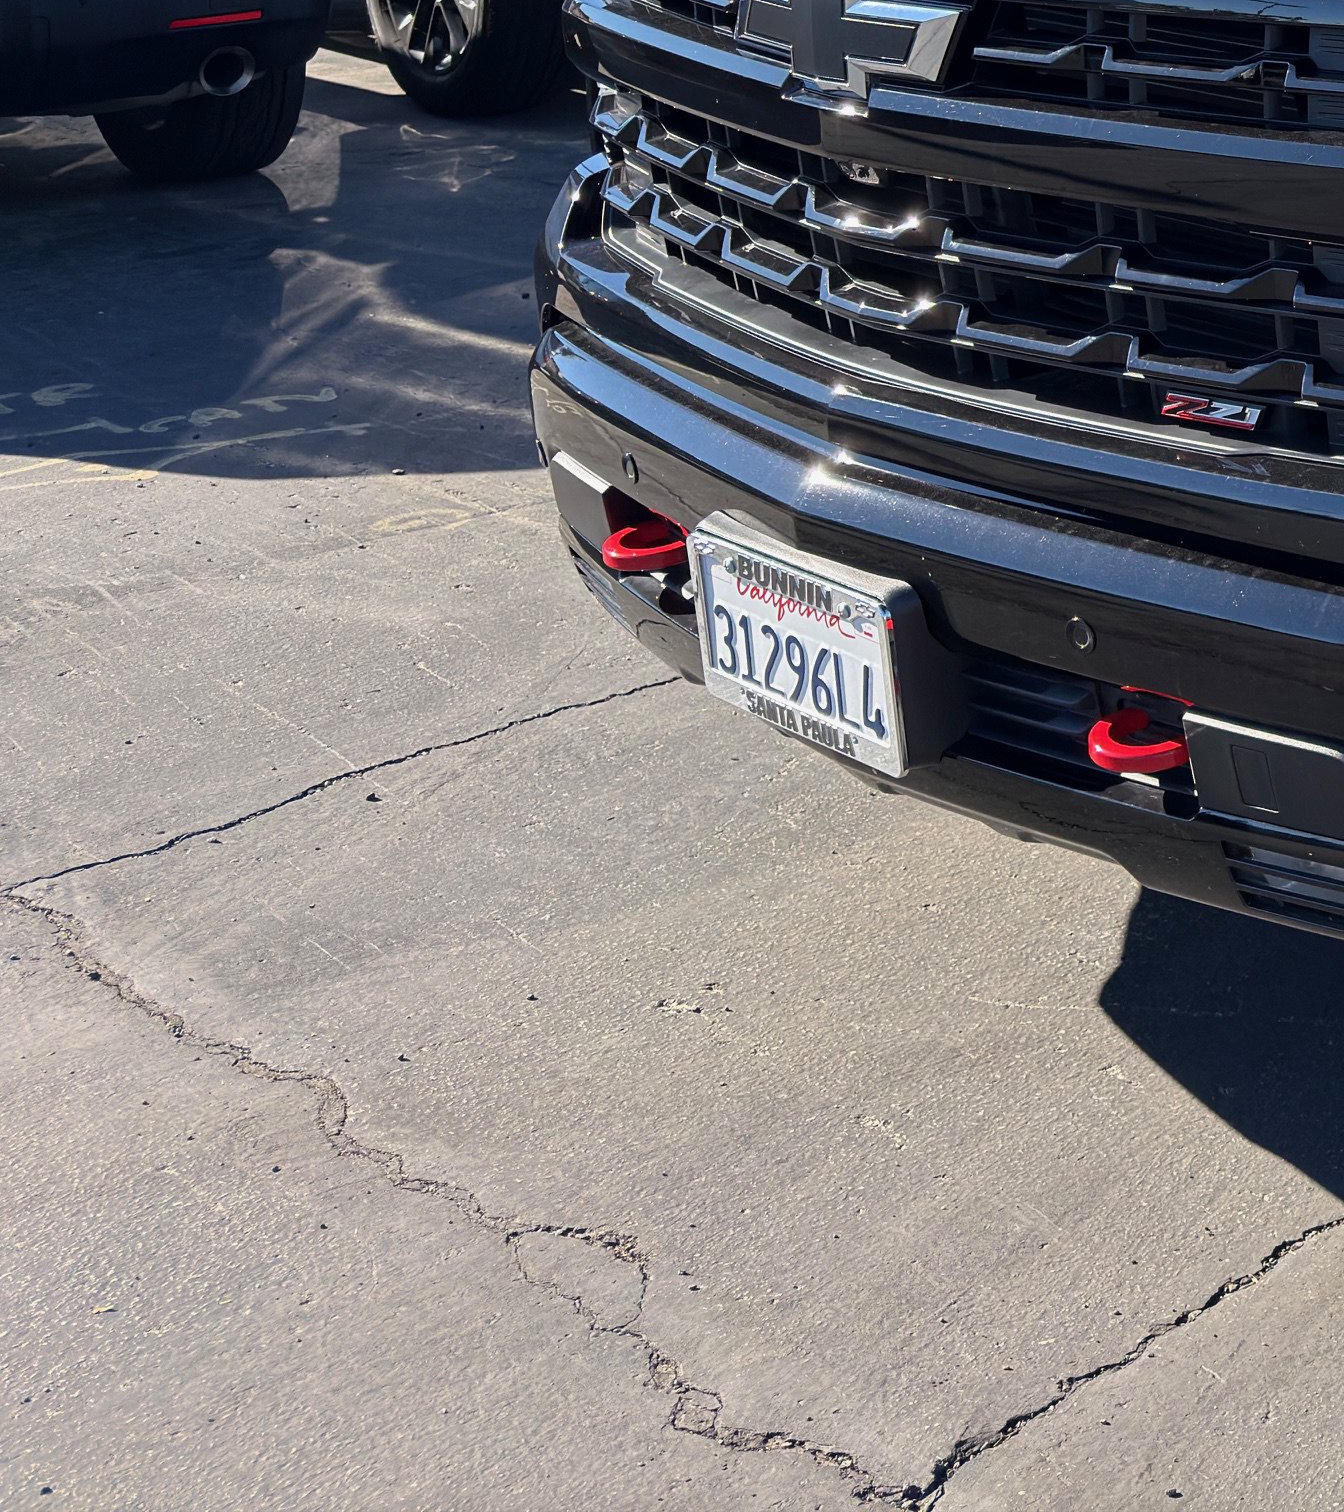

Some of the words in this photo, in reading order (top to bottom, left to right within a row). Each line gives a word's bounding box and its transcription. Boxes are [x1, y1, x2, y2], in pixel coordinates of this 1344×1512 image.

[1161, 392, 1261, 431] Z71
[737, 552, 833, 613] BUNNIN
[714, 605, 886, 740] 31296L4
[746, 690, 799, 733] SANTA
[800, 714, 857, 758] PAULA
